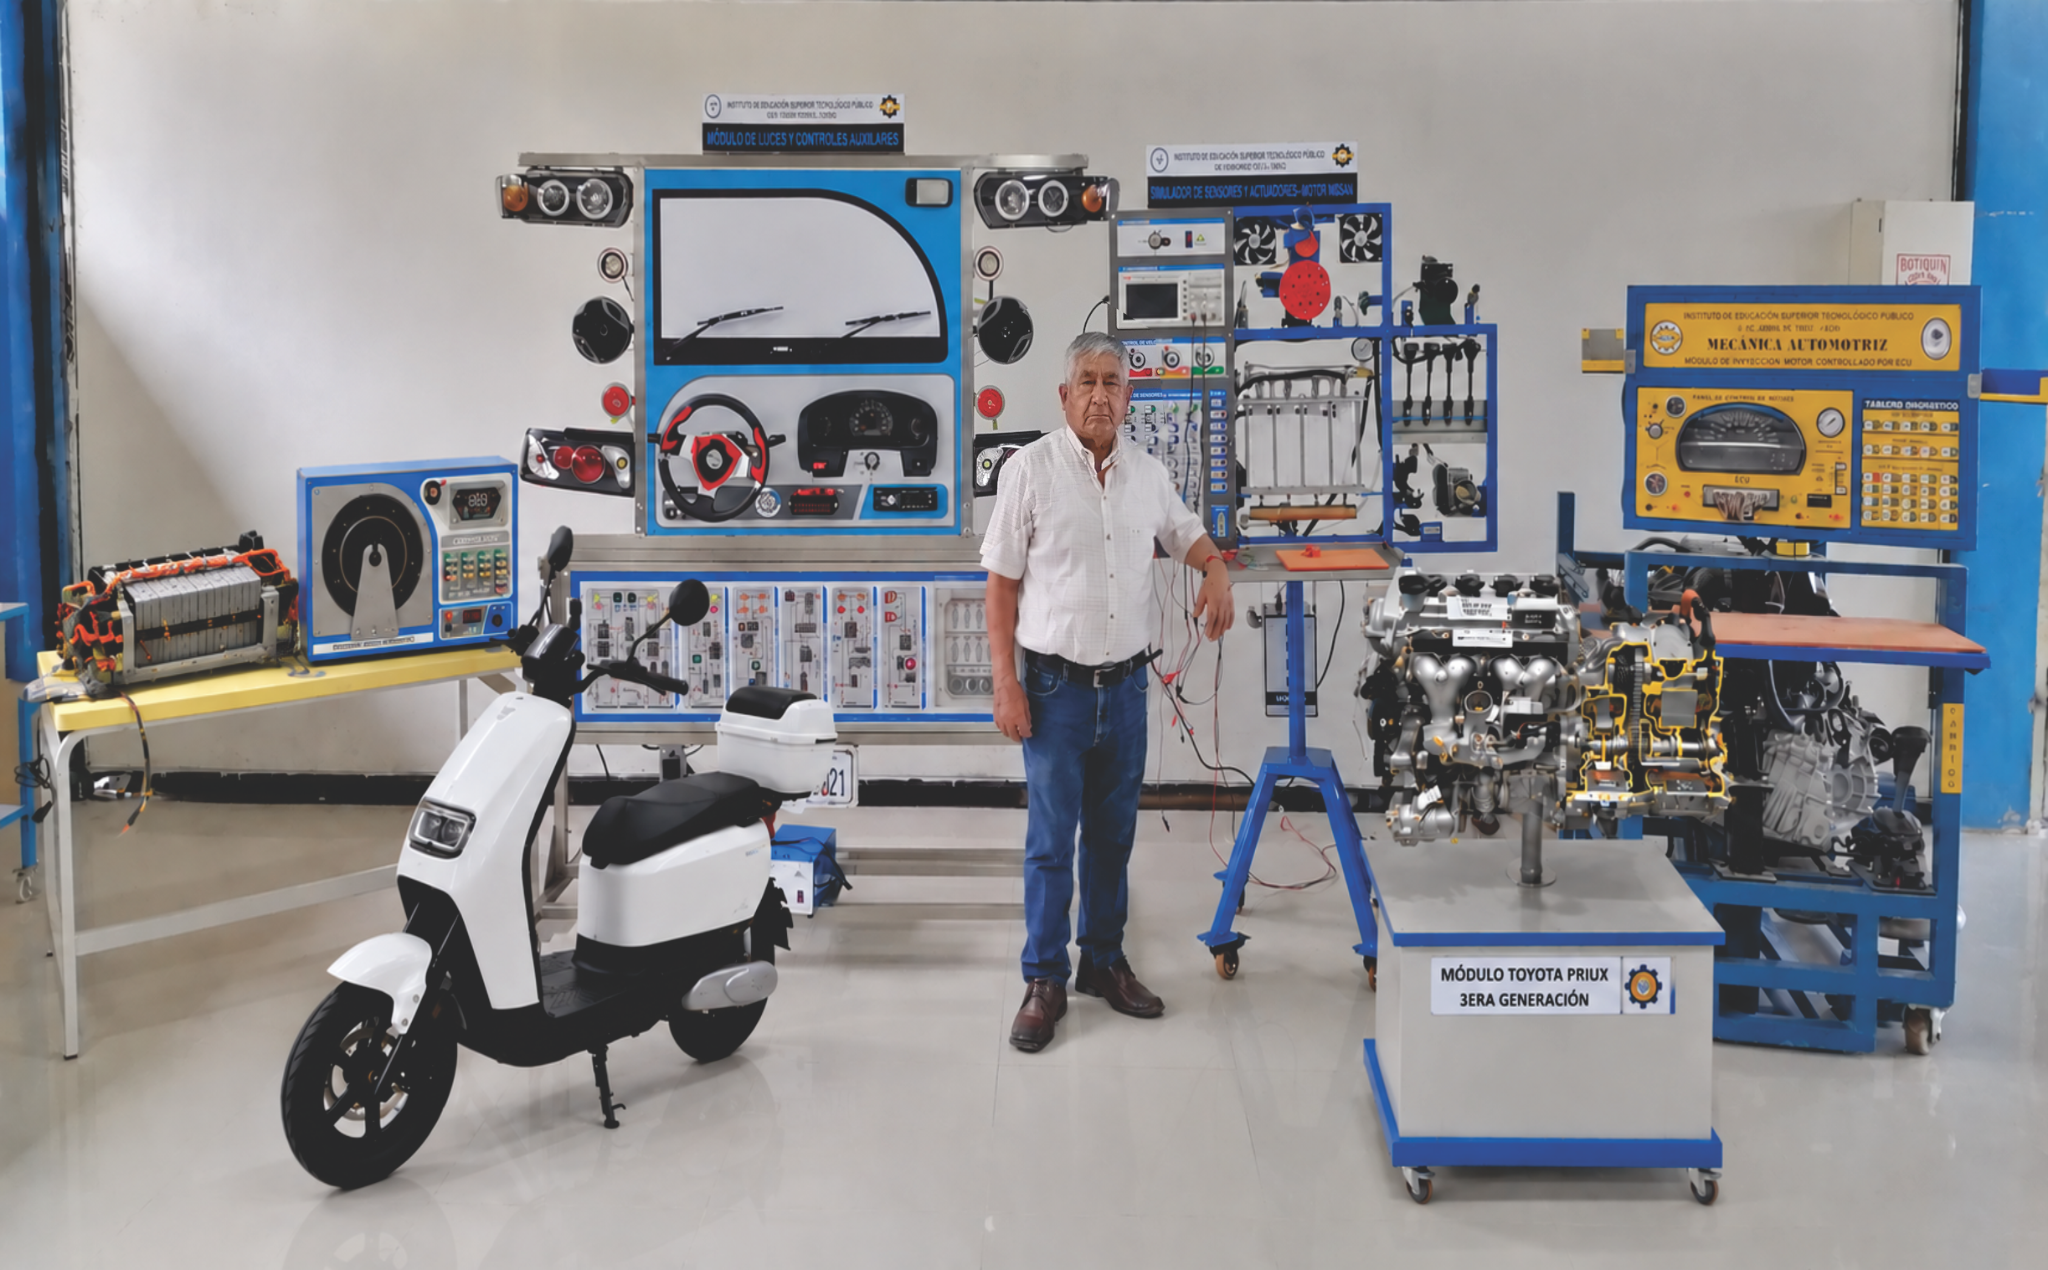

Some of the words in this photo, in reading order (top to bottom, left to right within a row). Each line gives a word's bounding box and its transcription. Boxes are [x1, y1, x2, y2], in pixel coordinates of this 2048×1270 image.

[707, 127, 744, 146] MÓDULO
[745, 131, 756, 146] DE
[758, 131, 787, 146] LUCES
[788, 131, 794, 146] Y
[795, 131, 848, 146] CONTROLES
[1193, 186, 1203, 199] DE
[1900, 257, 1947, 274] BOTIQUIN
[1684, 312, 1721, 320] INSTITUTO
[1723, 312, 1732, 320] DE
[1707, 334, 1782, 351] MECÁNICA
[1787, 338, 1888, 351] AUTOMOTRIZ
[1784, 357, 1813, 366] MOTOR
[1895, 358, 1912, 367] ECU
[1865, 400, 1903, 409] TABLERO
[1441, 964, 1504, 982] MÓDULO
[1508, 968, 1563, 982] TOYOTA
[1567, 968, 1609, 982] PRIUX
[1460, 993, 1495, 1007] 3ERA
[1499, 989, 1589, 1007] GENERACIÓN
